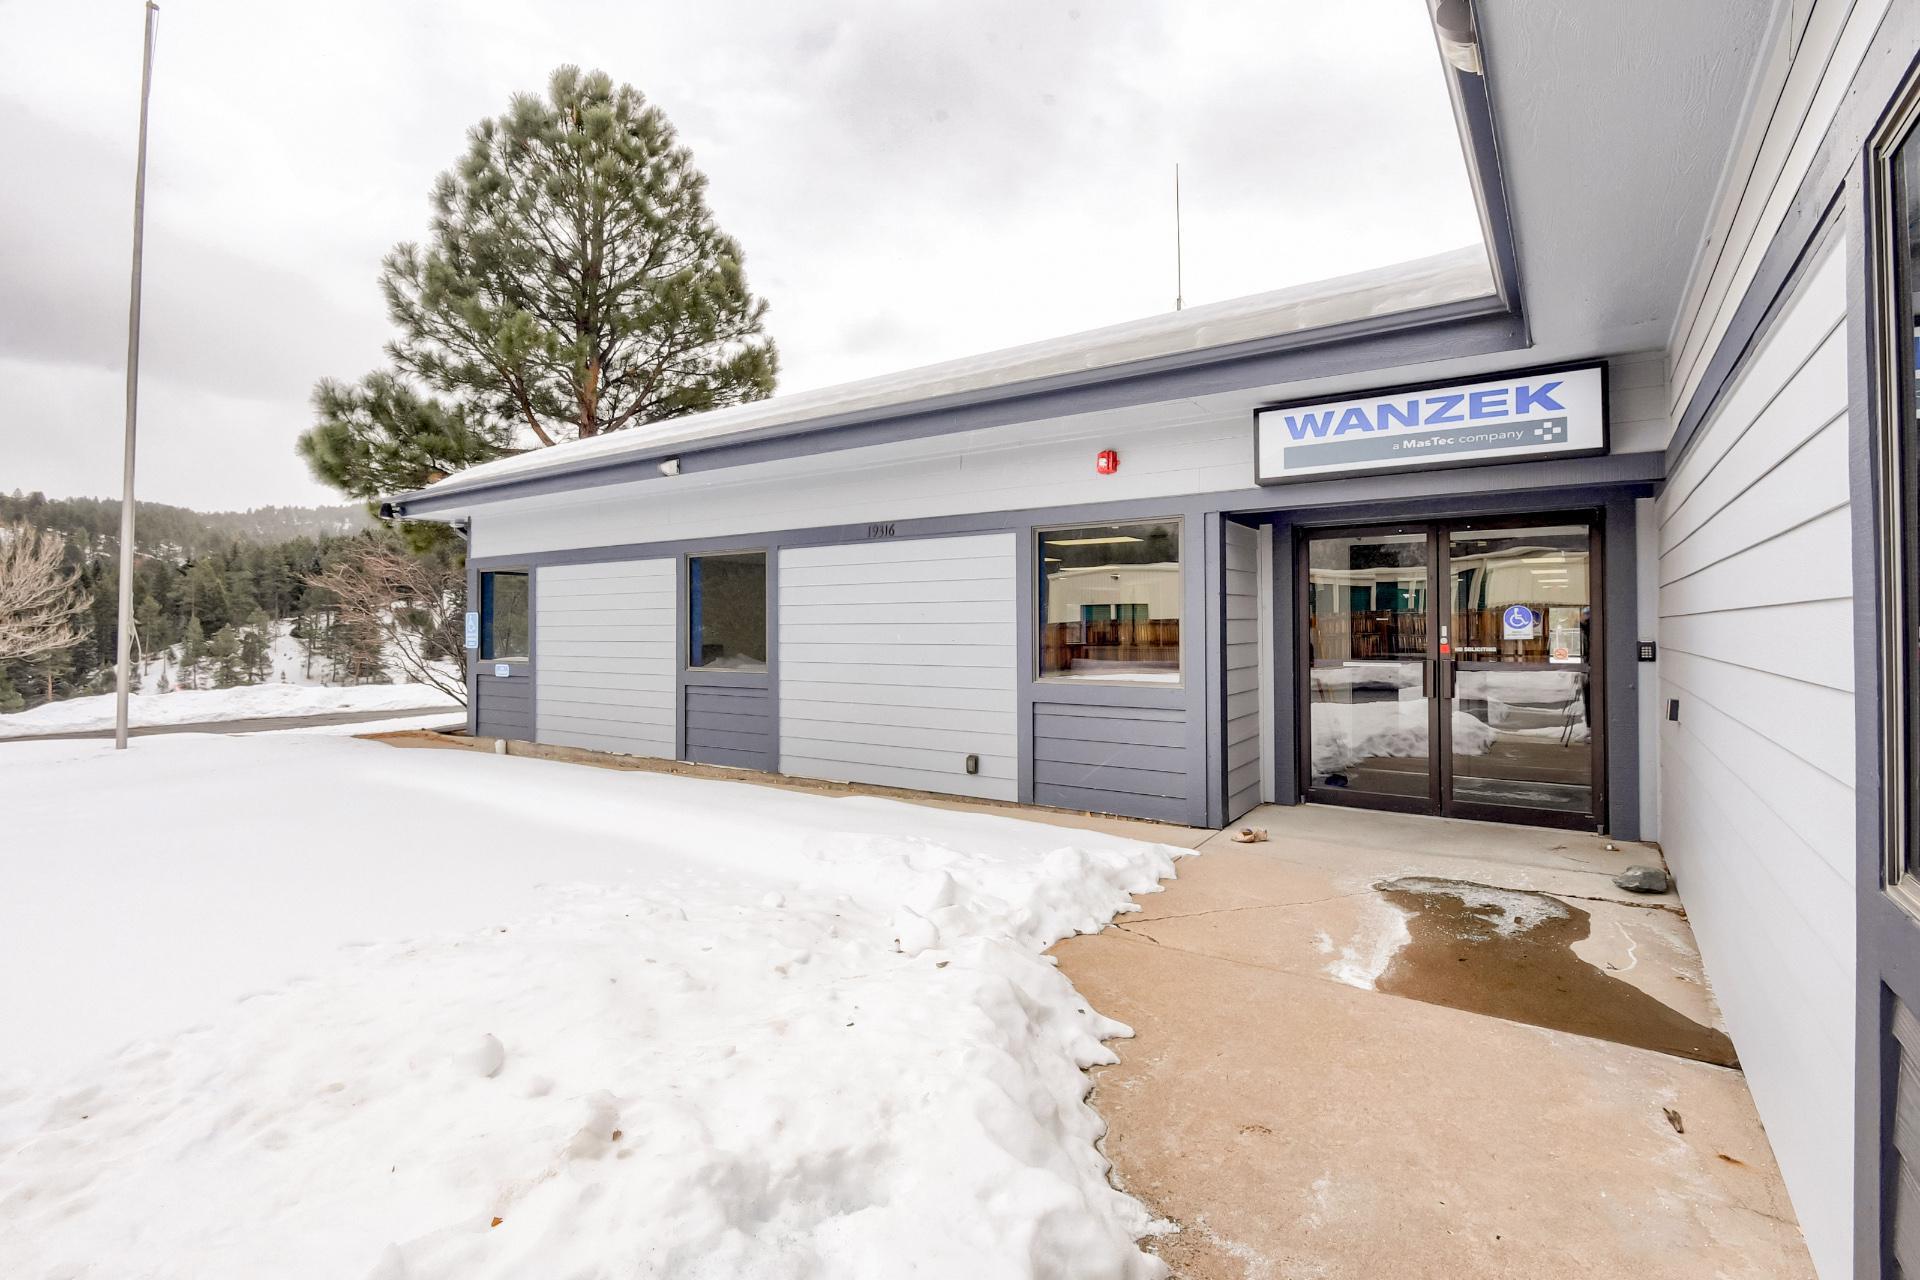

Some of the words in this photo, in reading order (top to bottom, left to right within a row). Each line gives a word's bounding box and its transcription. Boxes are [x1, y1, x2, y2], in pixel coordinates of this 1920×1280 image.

[1284, 381, 1566, 440] WANZEK
[1402, 437, 1455, 449] MasTec
[1458, 430, 1524, 443] company
[867, 523, 896, 538] 19316
